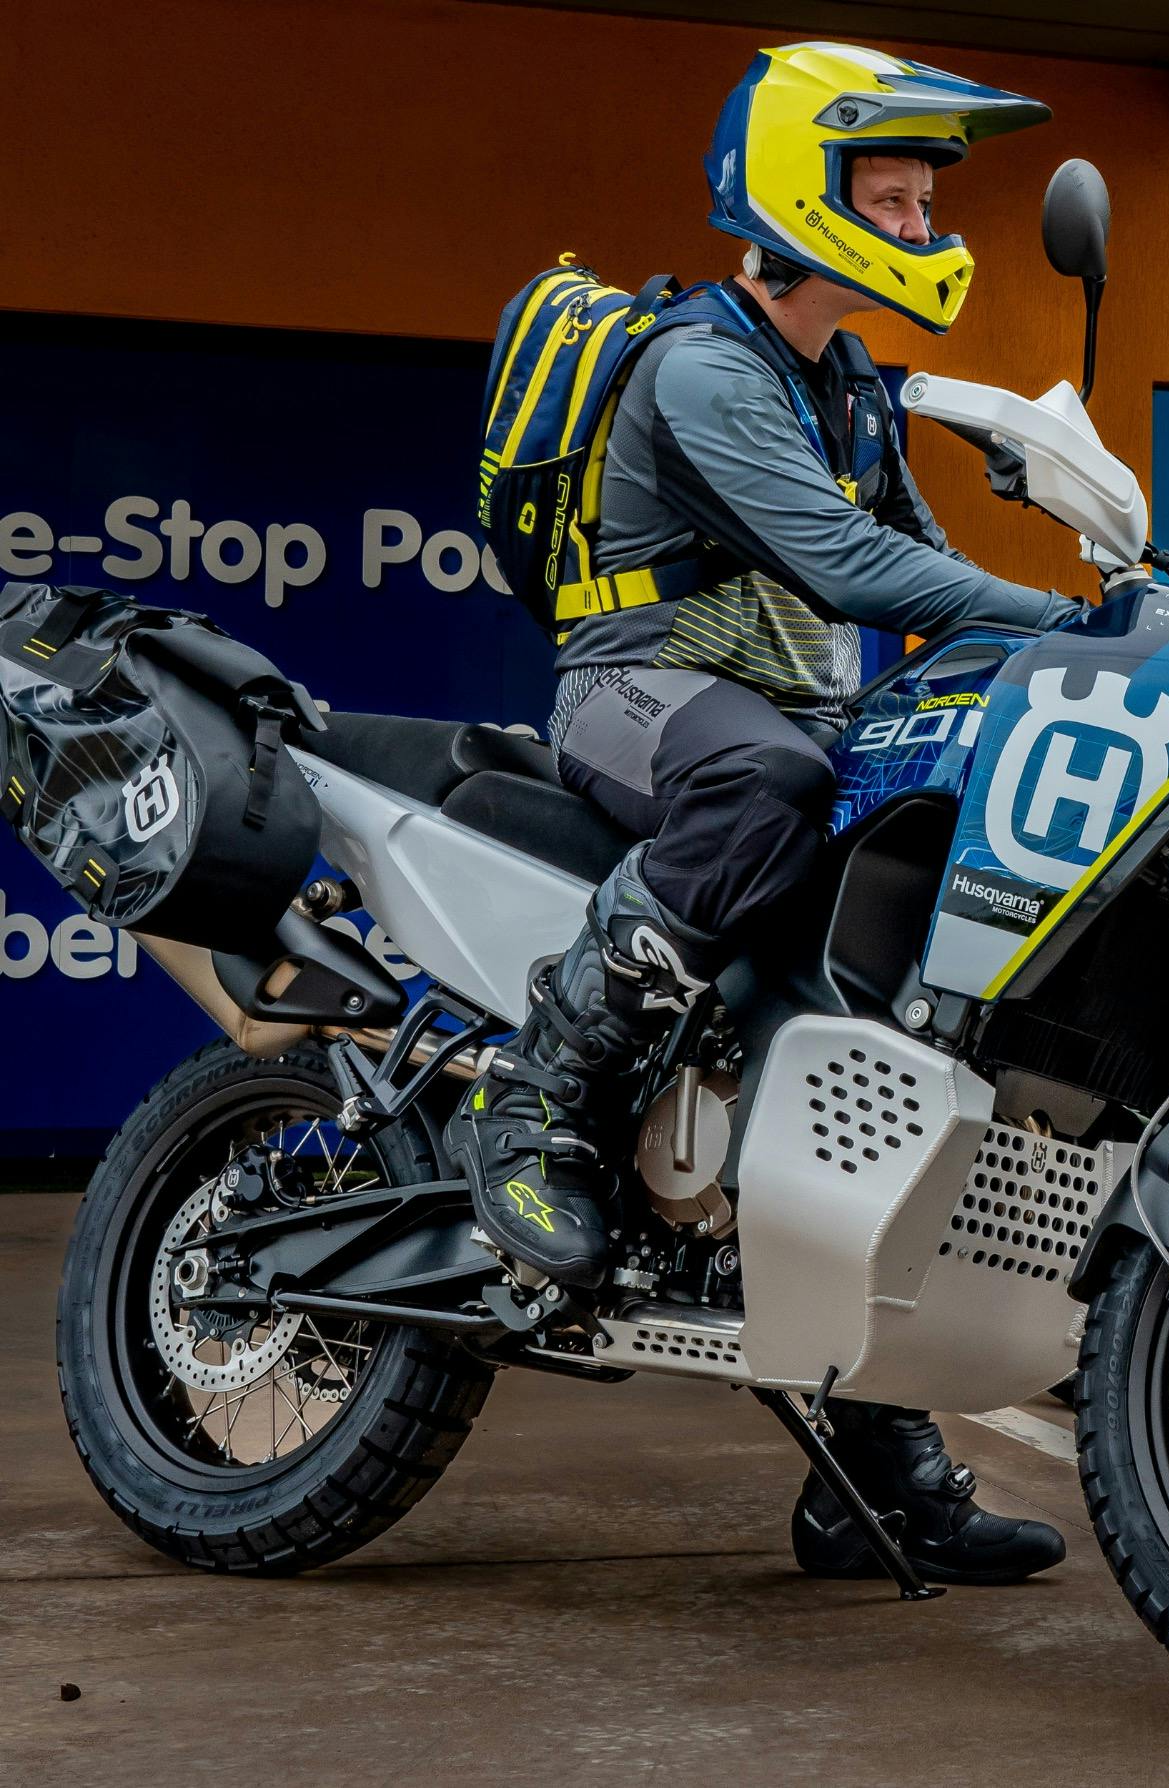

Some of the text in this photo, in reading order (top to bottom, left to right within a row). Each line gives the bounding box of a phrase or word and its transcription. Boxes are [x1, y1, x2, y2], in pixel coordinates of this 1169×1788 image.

[818, 222, 871, 269] Husqvarna
[0, 496, 327, 608] e-Stop
[610, 678, 666, 718] Husqvarna
[915, 692, 991, 712] NORDEN
[850, 708, 984, 752] 901
[952, 874, 1040, 914] Husqvarna
[992, 906, 1036, 924] MOTORCYCLES
